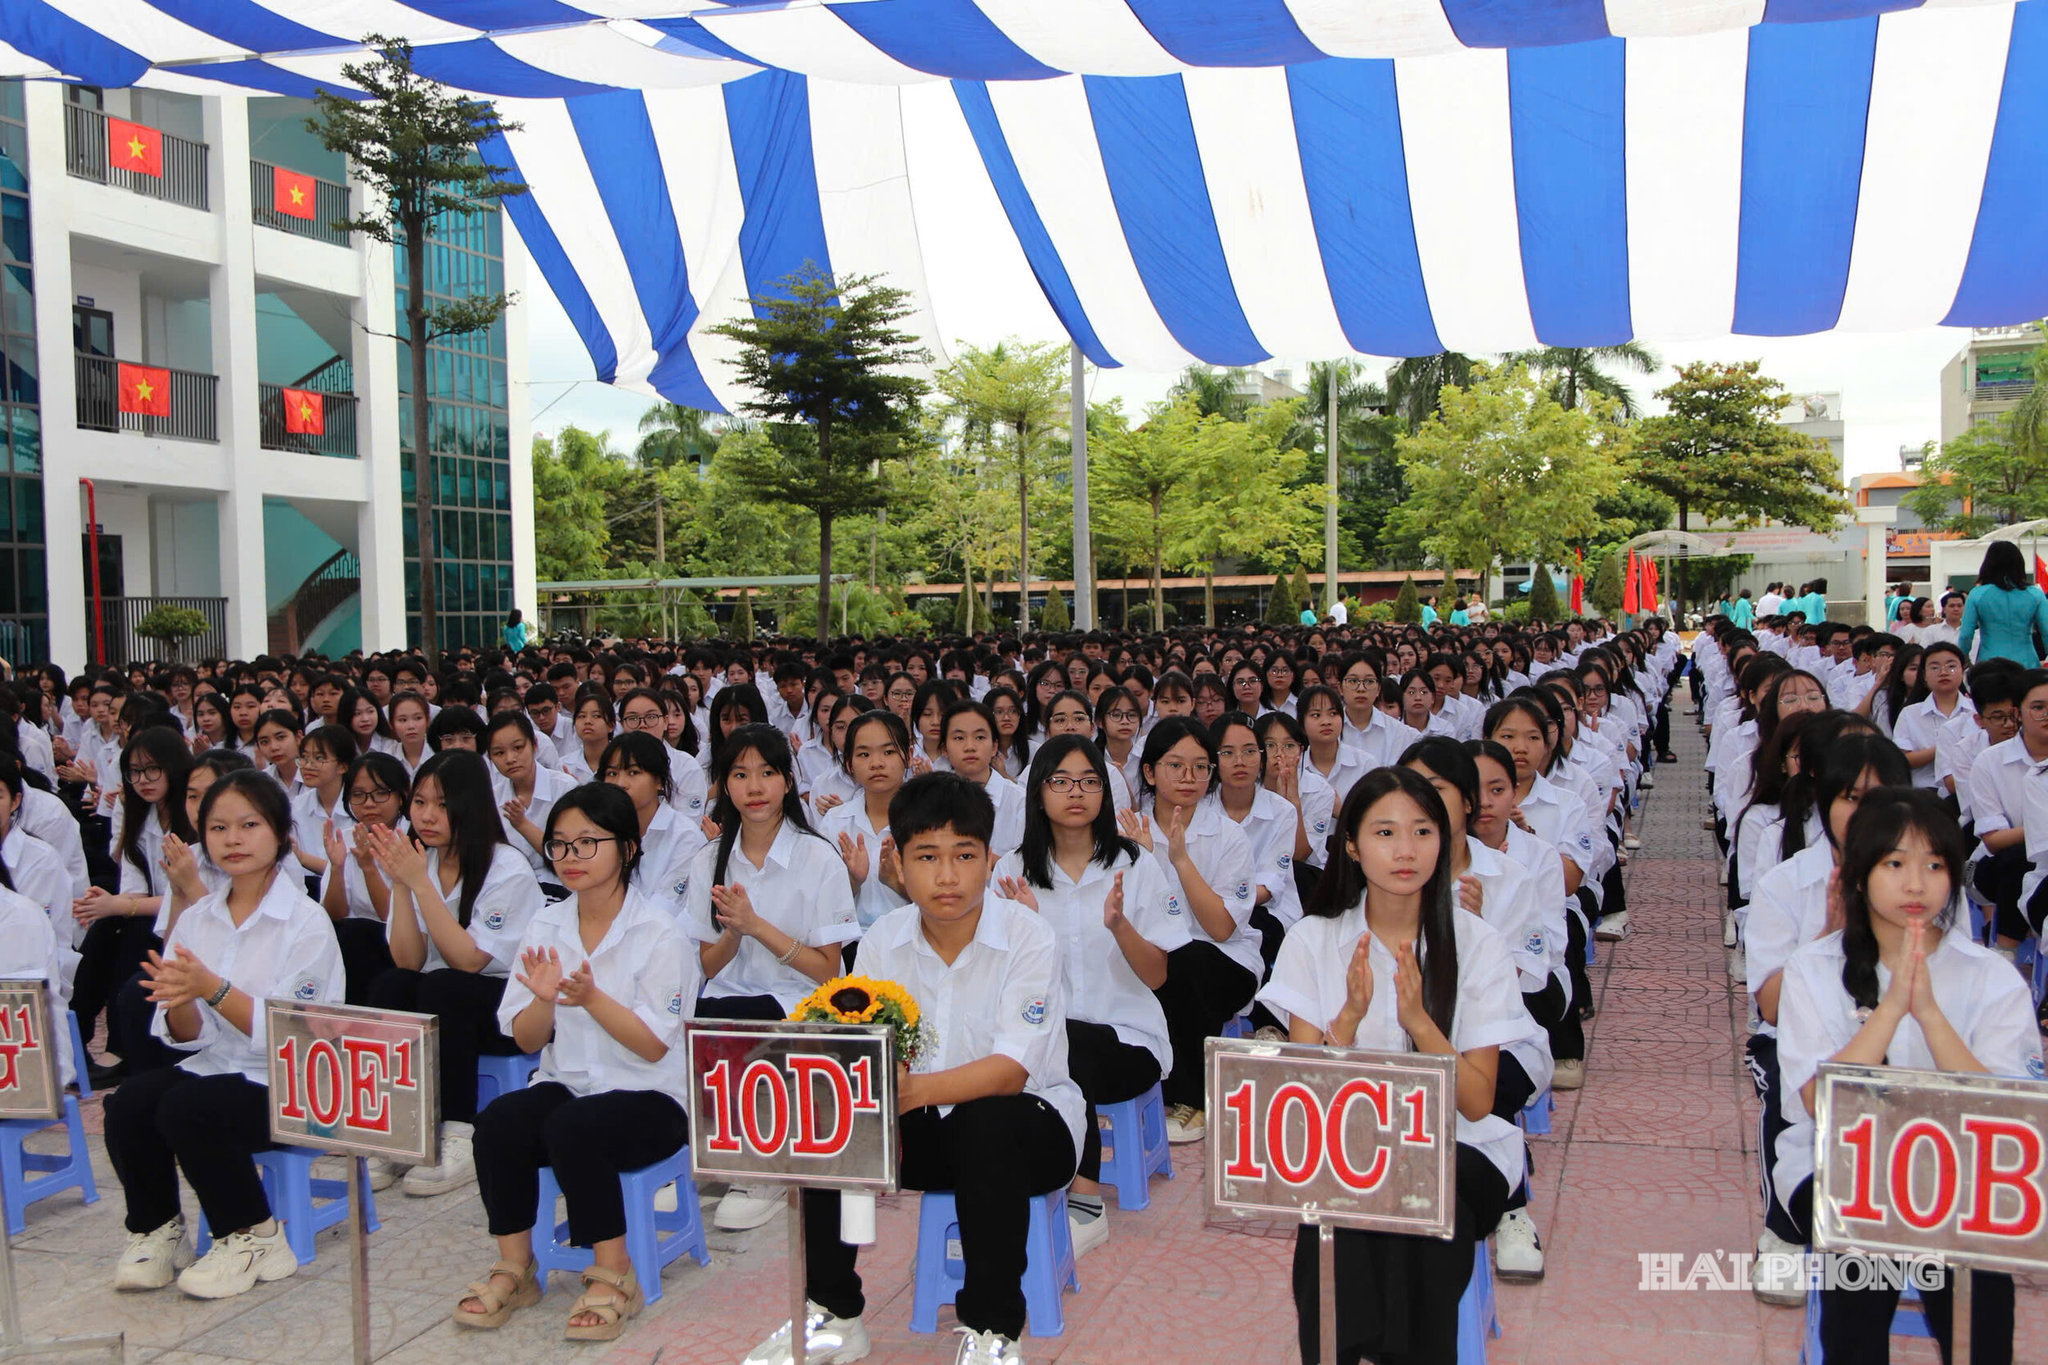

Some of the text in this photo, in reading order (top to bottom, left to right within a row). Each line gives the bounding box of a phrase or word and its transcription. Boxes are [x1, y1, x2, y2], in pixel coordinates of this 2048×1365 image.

[278, 1036, 417, 1134] 10E1
[704, 1053, 880, 1157] 10D1
[1225, 1077, 1434, 1194] 10C1
[1838, 1113, 2046, 1240] 10B
